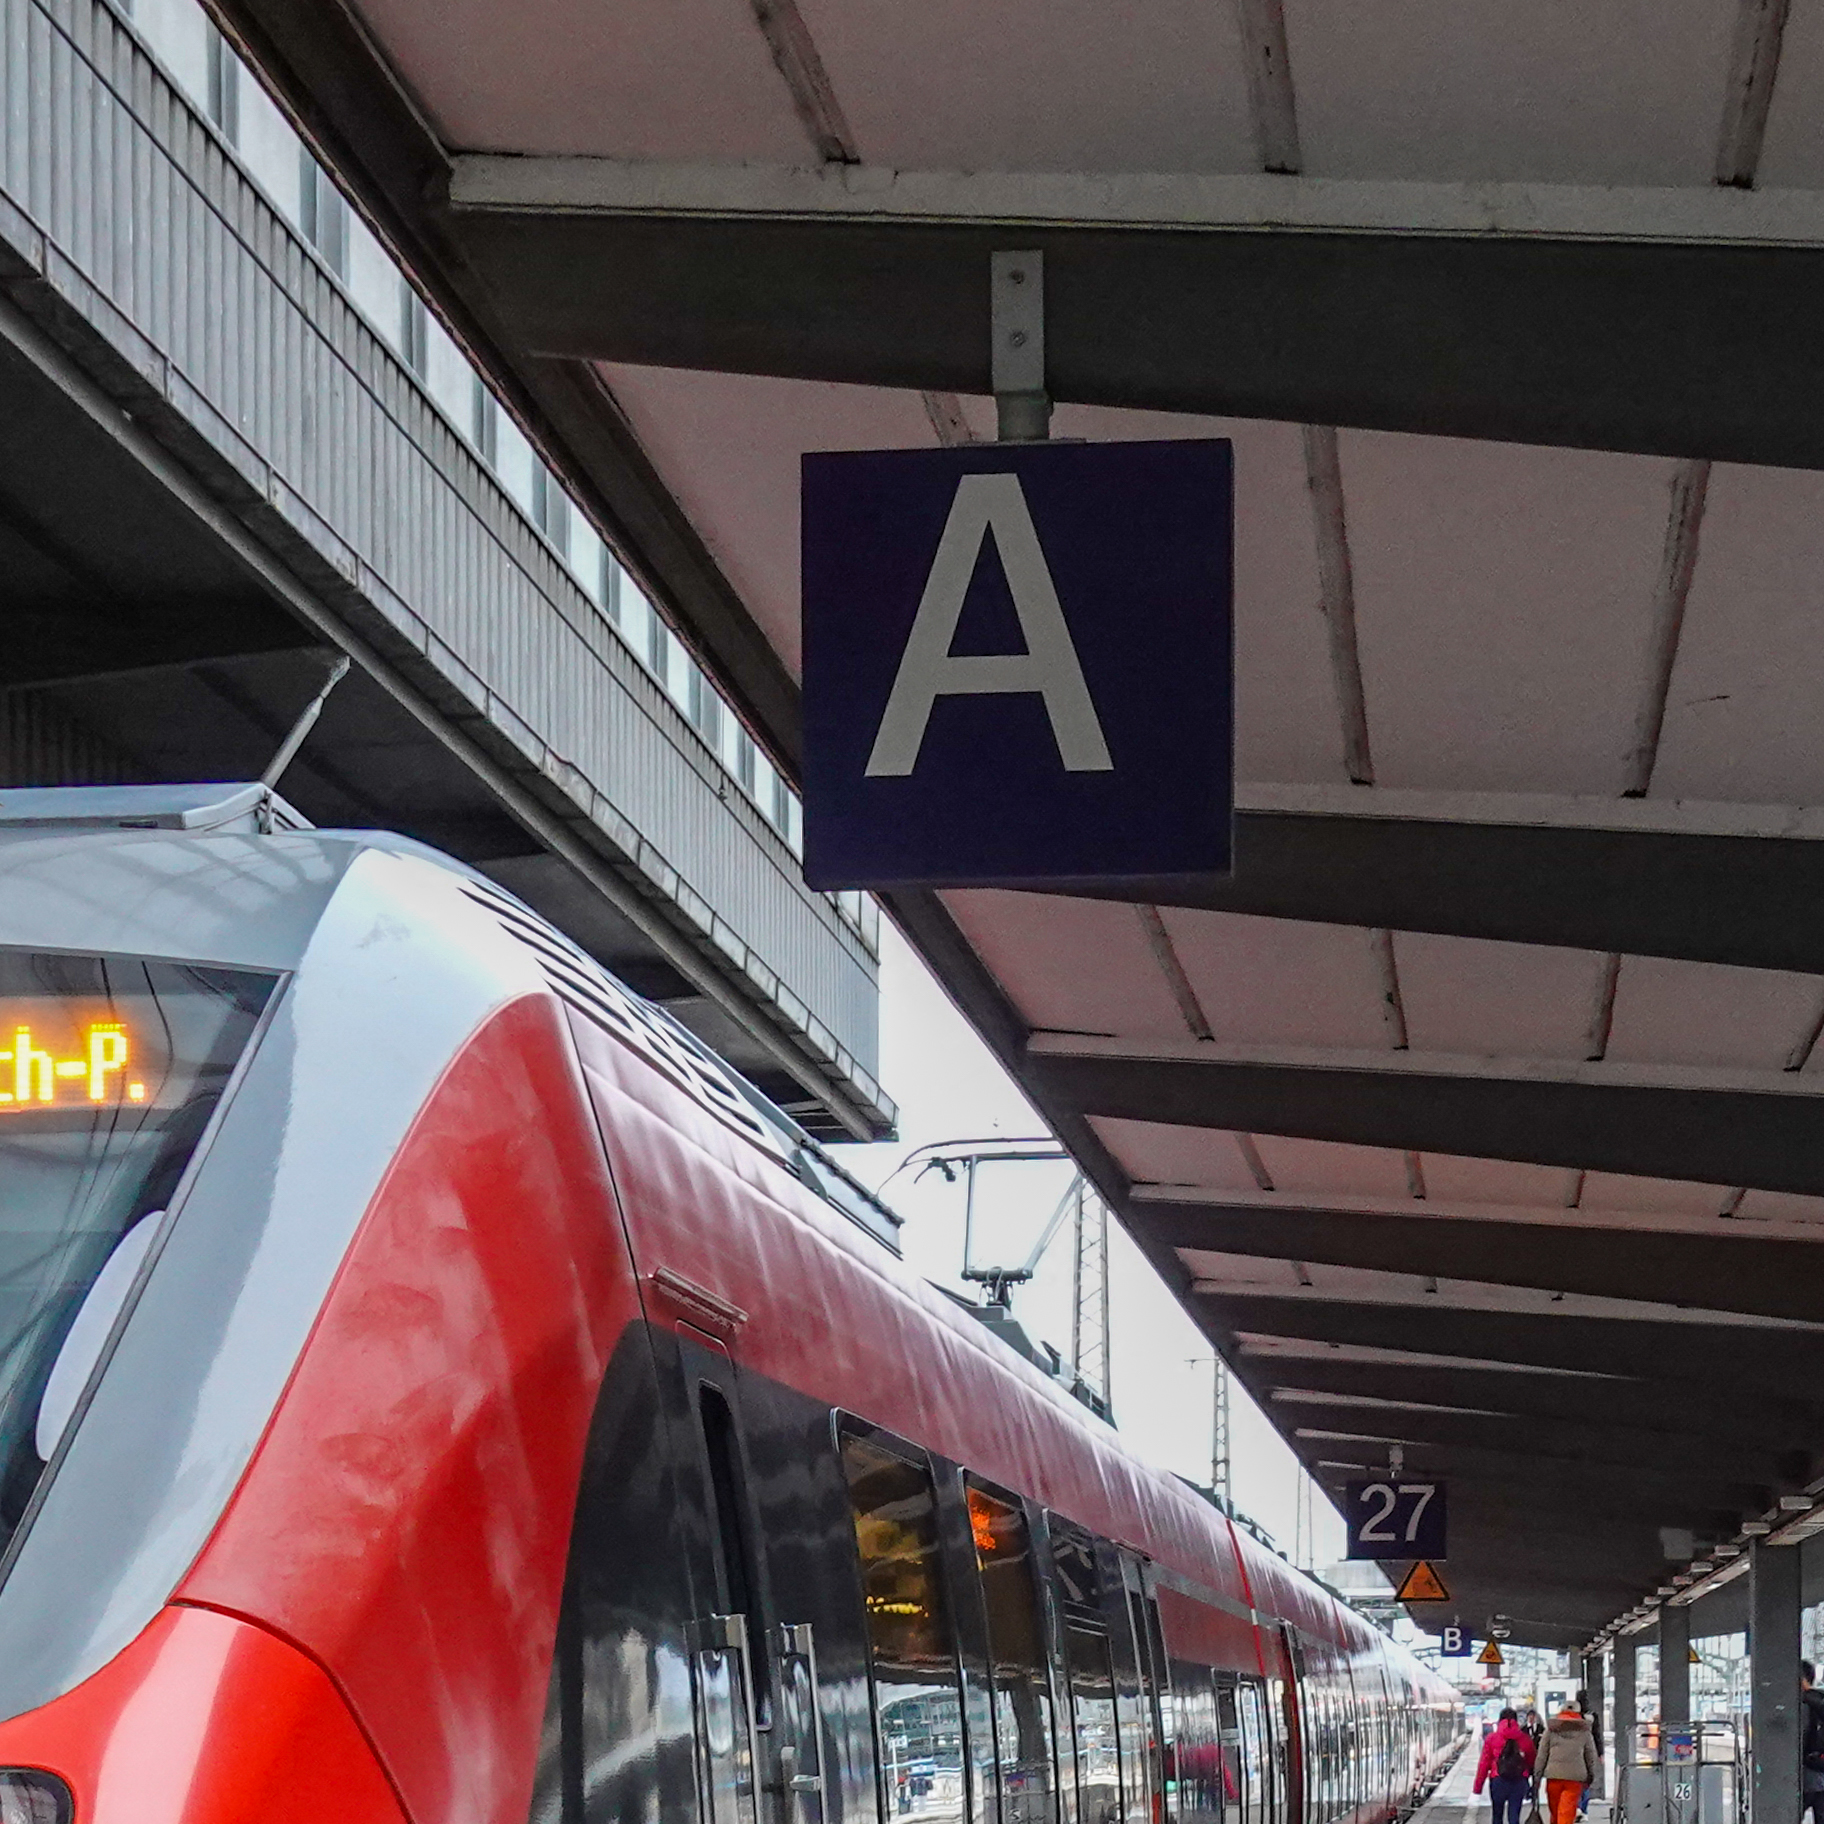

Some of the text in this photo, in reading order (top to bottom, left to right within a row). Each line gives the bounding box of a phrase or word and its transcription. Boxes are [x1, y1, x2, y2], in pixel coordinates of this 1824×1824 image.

[864, 472, 1115, 777] A
[1358, 1483, 1436, 1542] 27
[1443, 1627, 1462, 1652] B
[1675, 1784, 1691, 1800] 26
